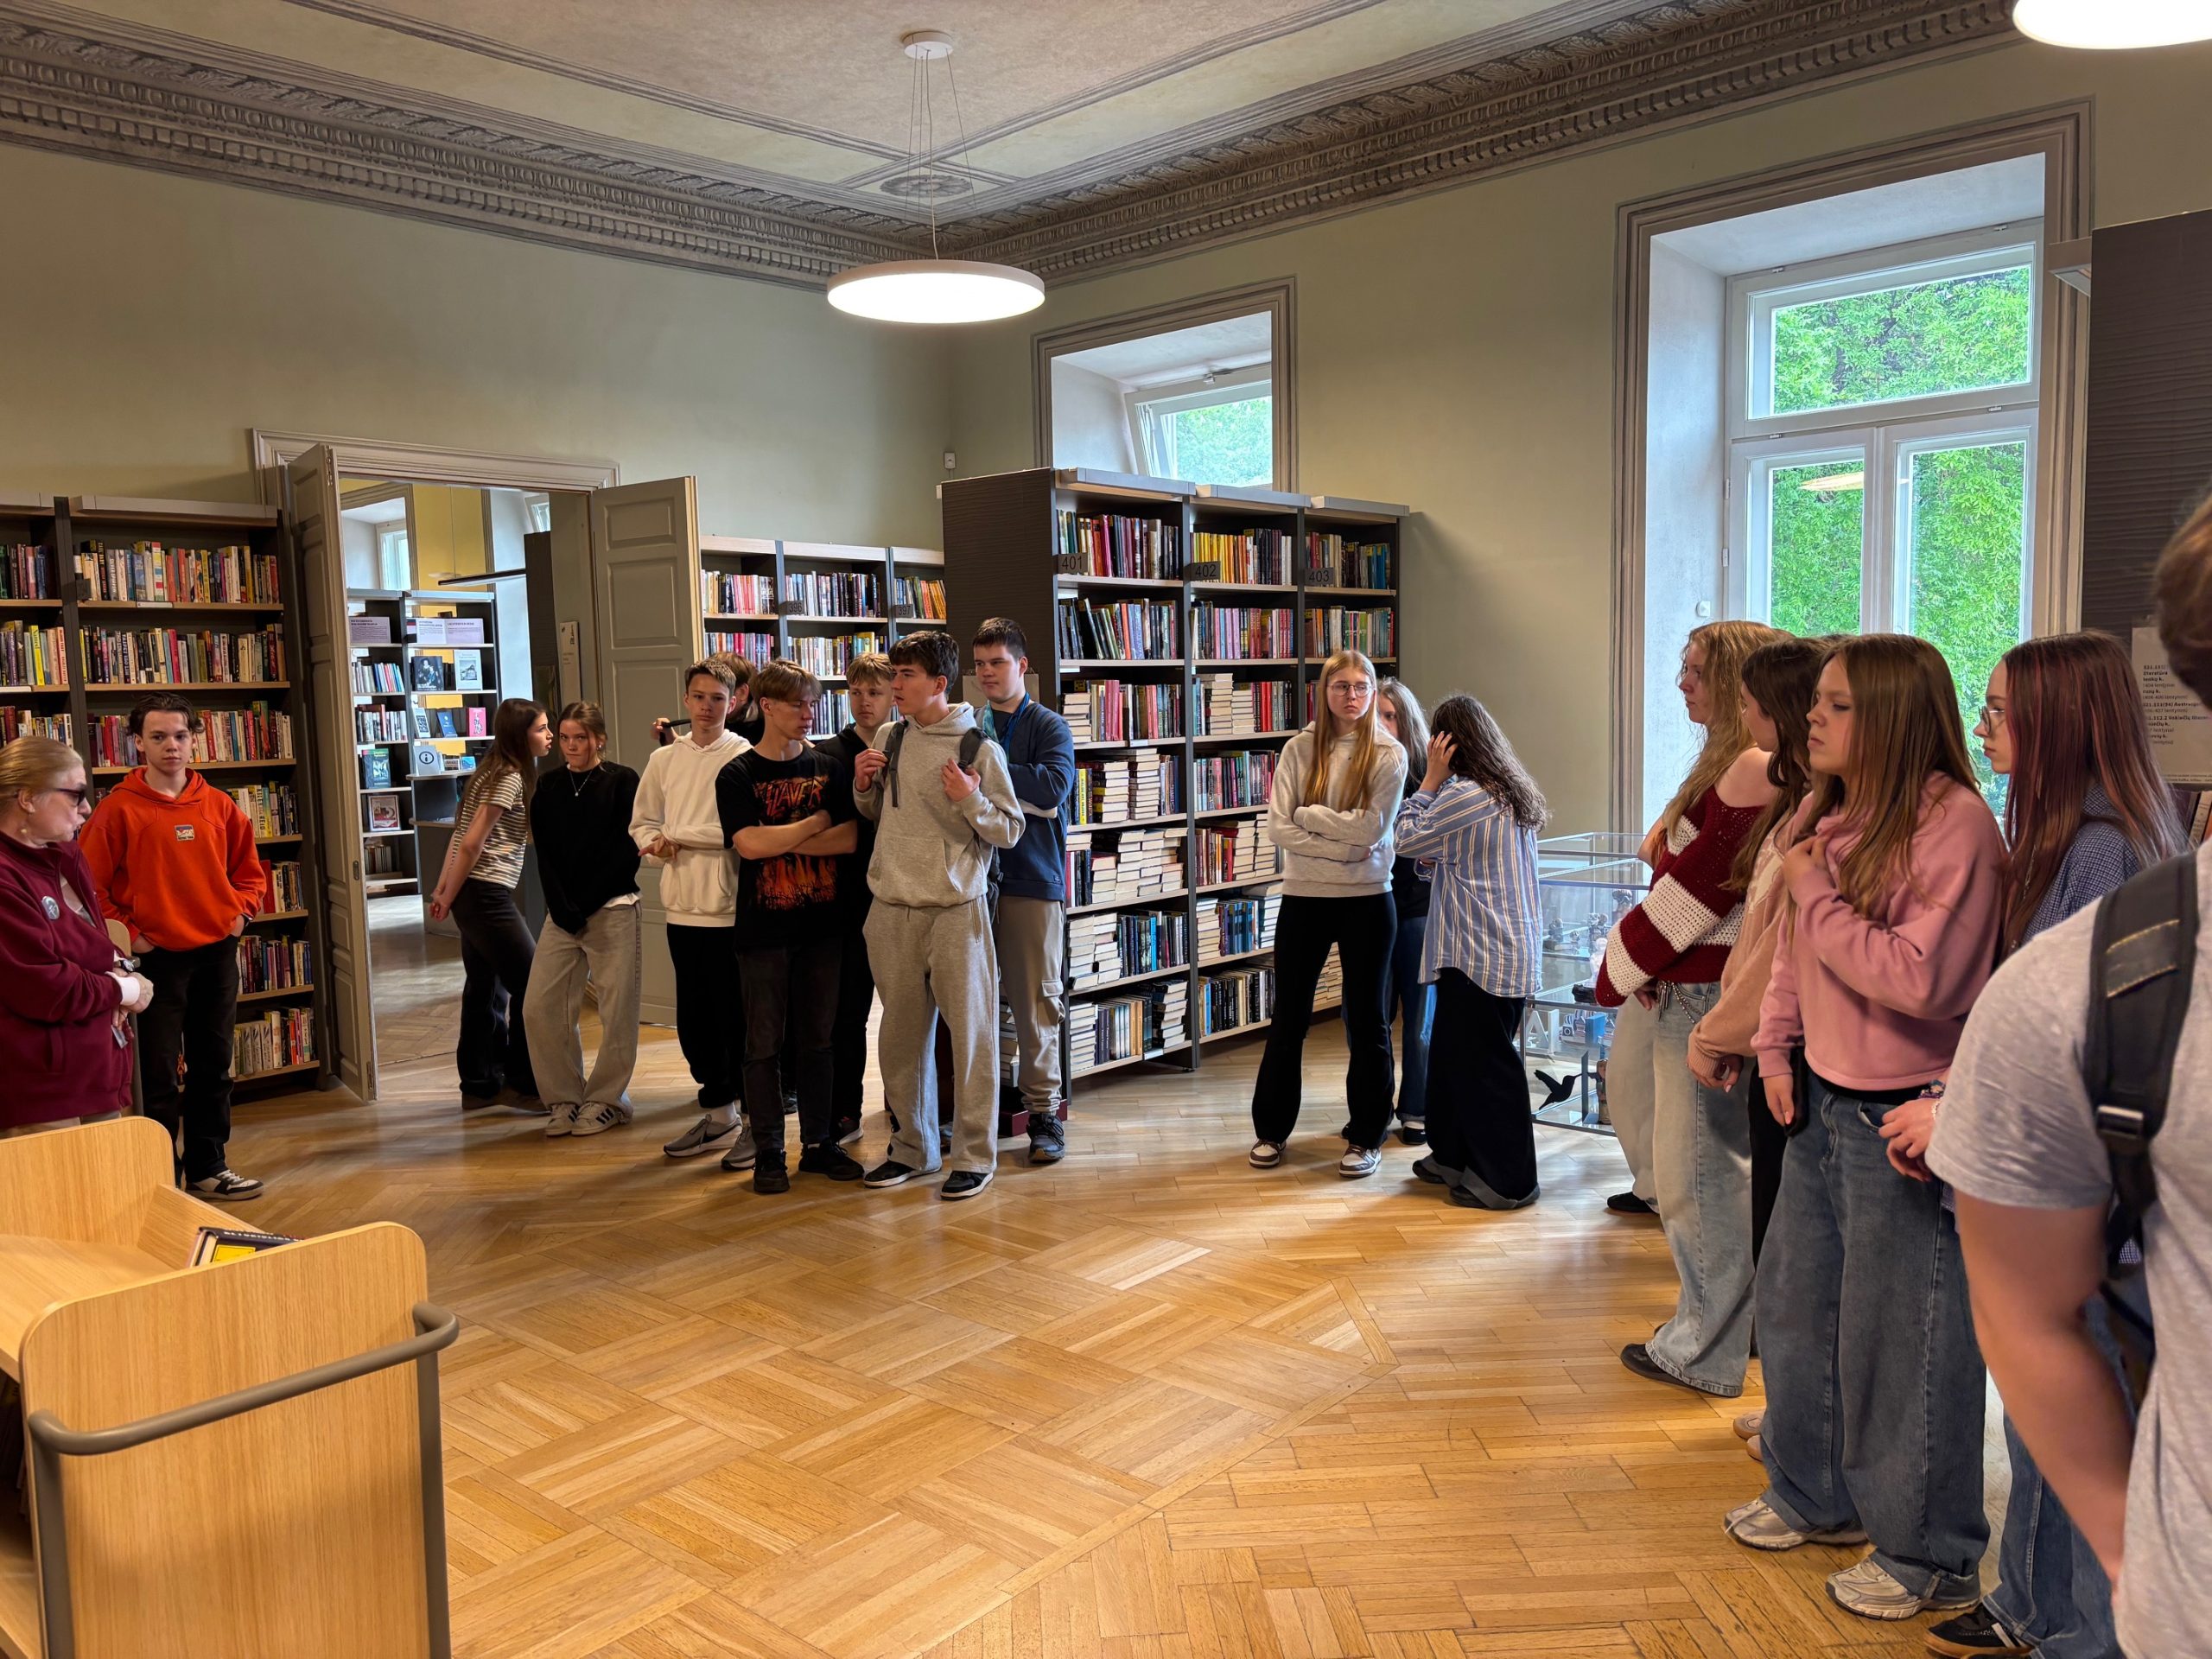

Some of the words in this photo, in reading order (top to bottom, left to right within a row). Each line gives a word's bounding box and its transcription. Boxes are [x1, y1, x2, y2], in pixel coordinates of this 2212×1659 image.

[1062, 556, 1082, 570] 401
[1195, 563, 1217, 578] 402
[1309, 571, 1330, 583] 403
[789, 601, 802, 613] 396
[898, 606, 911, 616] 397
